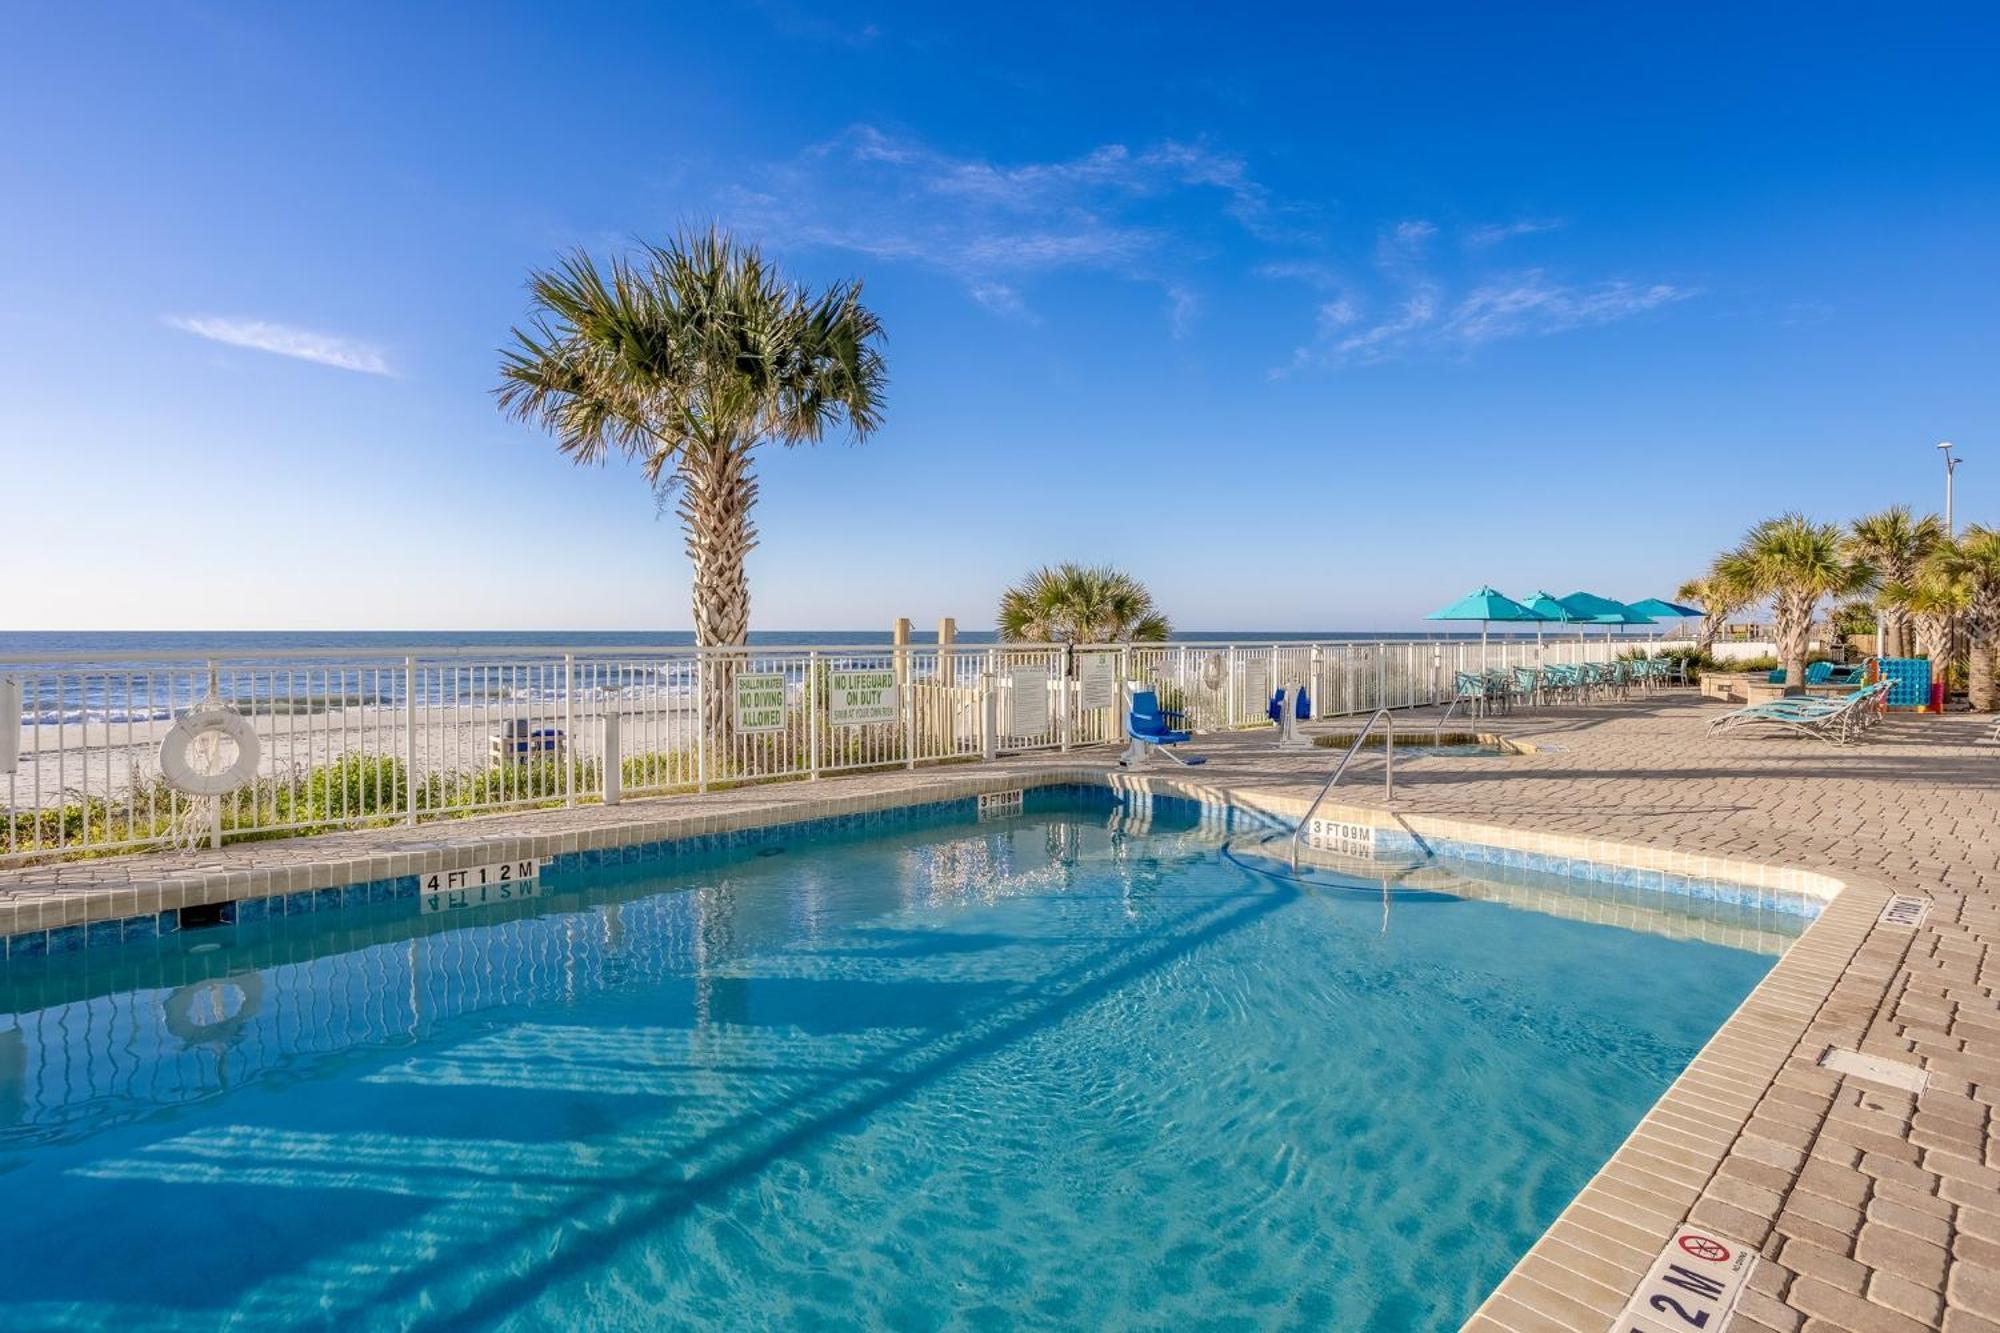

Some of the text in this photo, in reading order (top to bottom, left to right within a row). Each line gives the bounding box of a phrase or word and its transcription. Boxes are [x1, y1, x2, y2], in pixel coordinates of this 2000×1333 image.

[739, 678, 783, 690] SHALLOW WATER
[834, 674, 893, 690] NO LIFEGUARD
[739, 691, 782, 708] NO DIVING
[846, 691, 882, 706] ON DUTY
[743, 711, 781, 727] ALLOWED
[428, 875, 440, 891] 4
[448, 870, 468, 889] FT
[1650, 1264, 1726, 1329] 2 M
